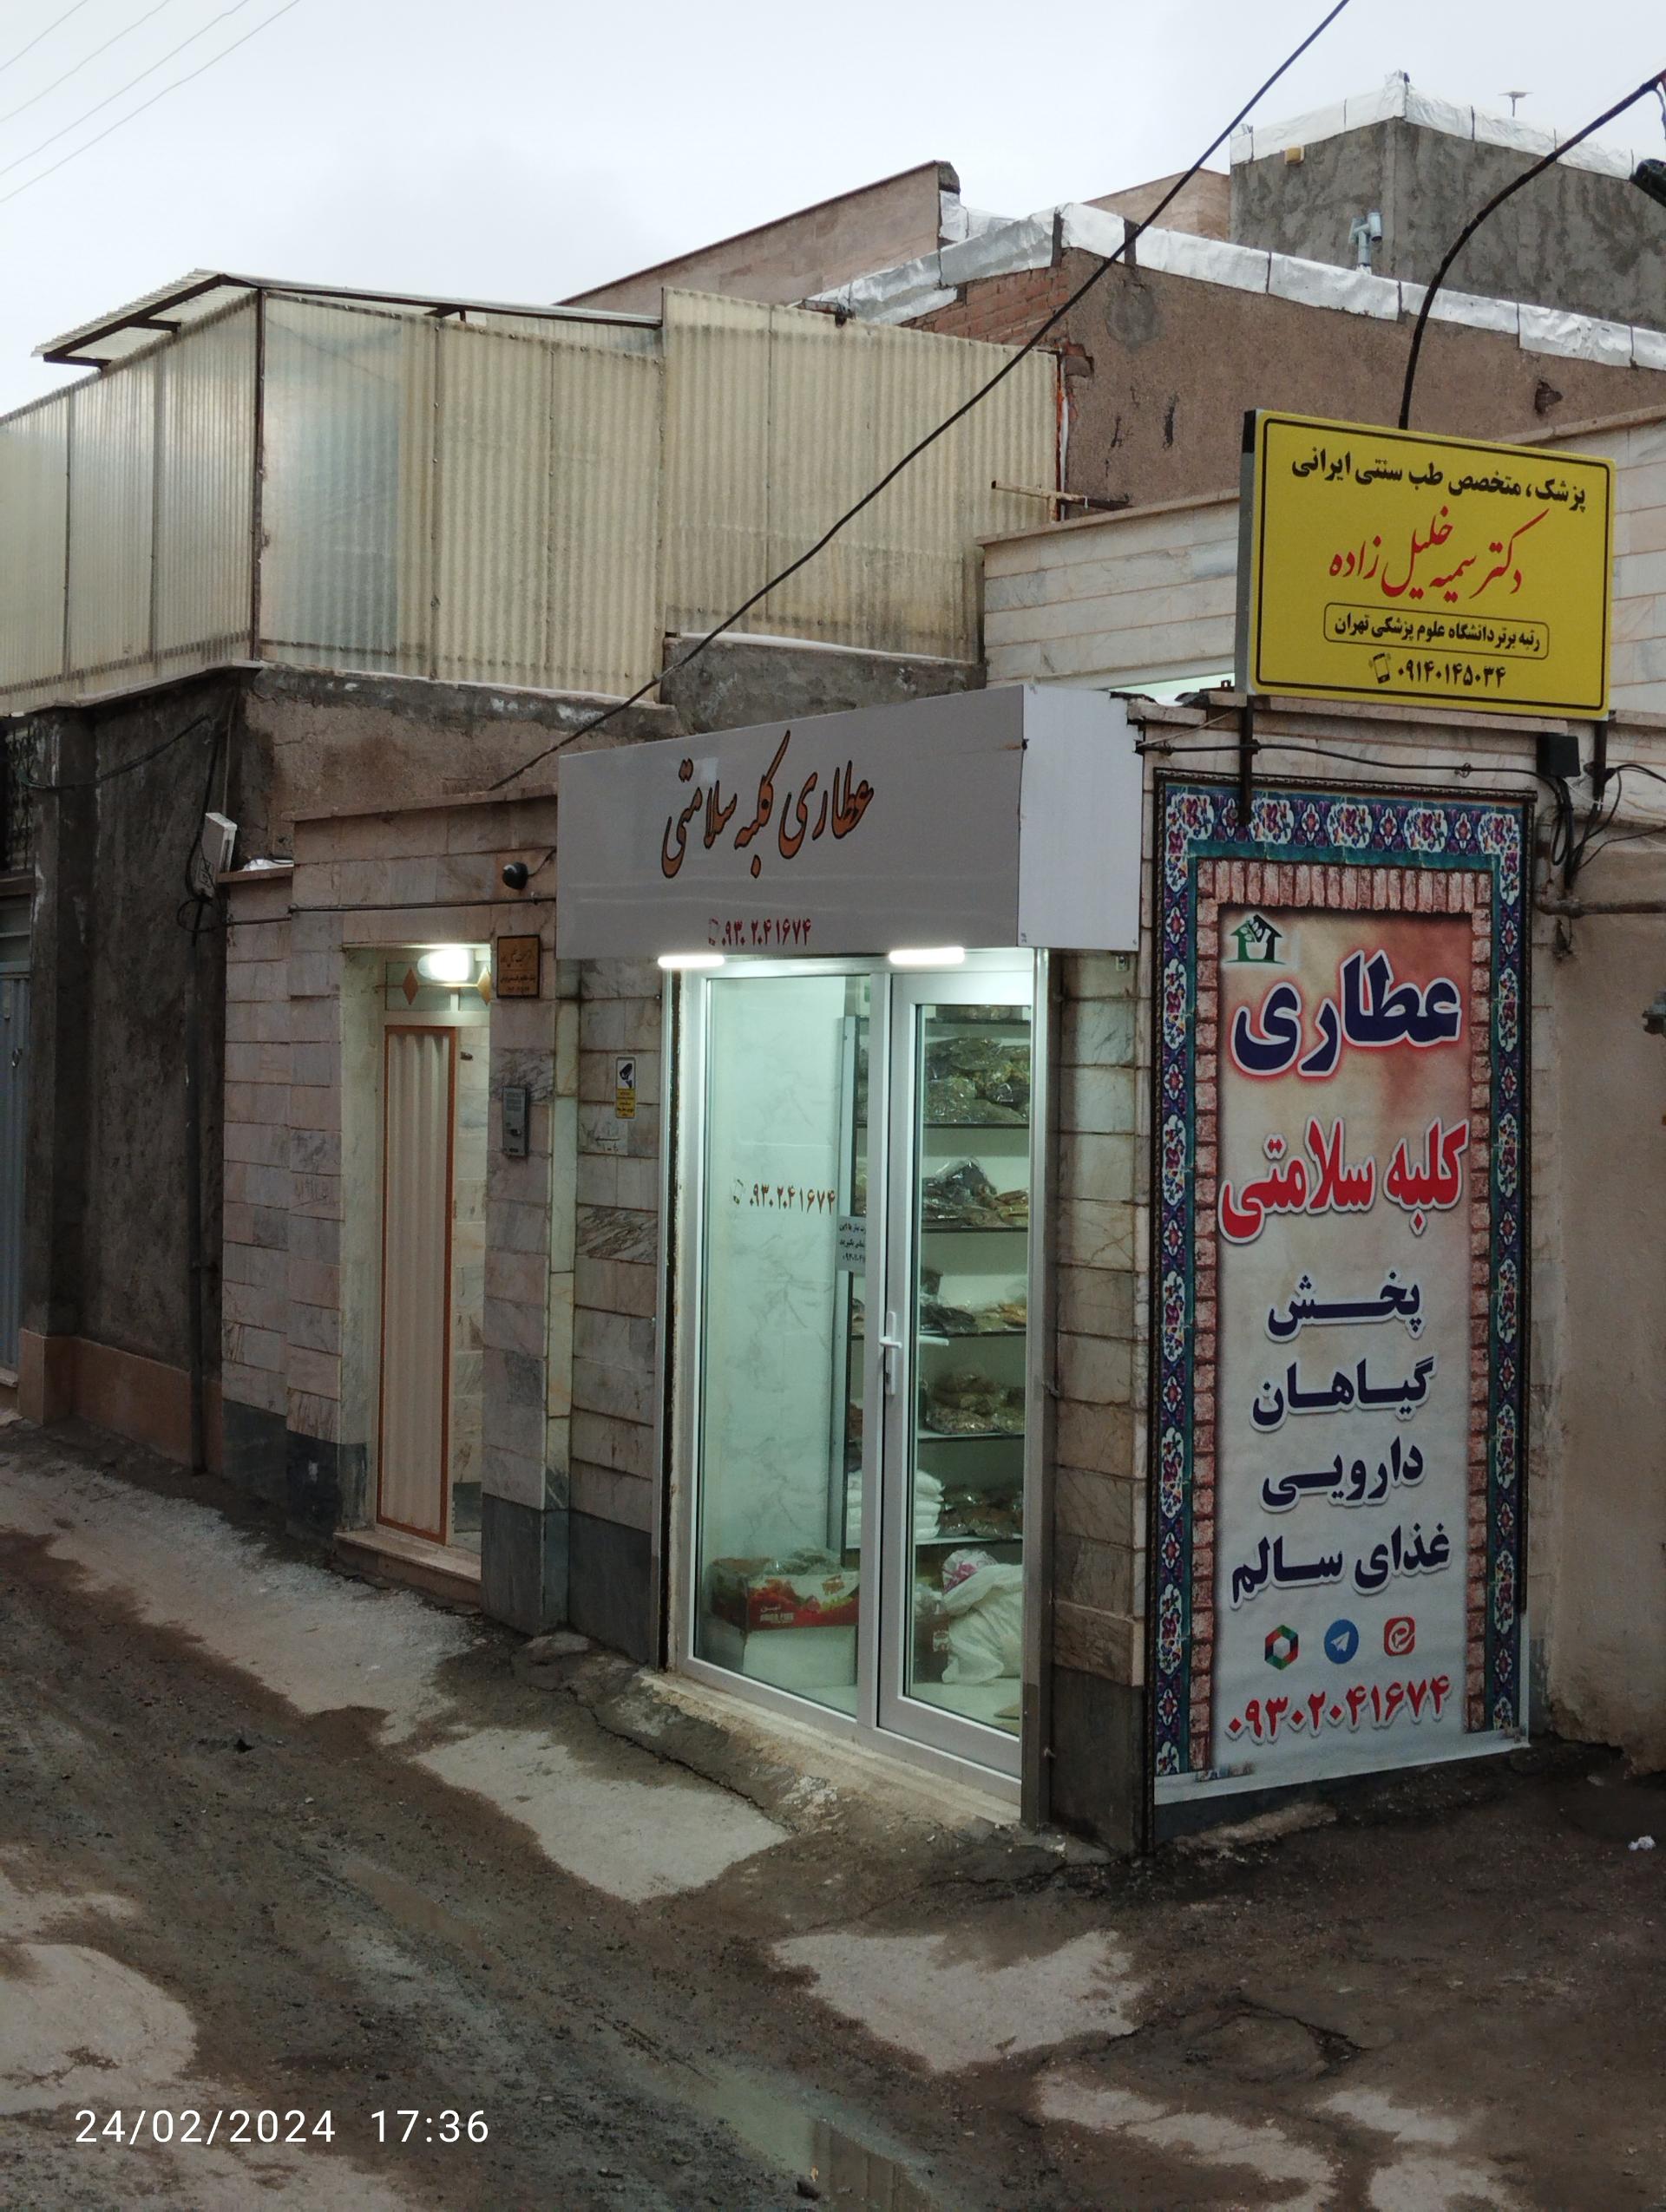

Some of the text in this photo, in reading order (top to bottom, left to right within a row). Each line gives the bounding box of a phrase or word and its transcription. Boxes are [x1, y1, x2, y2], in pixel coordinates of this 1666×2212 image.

[1291, 447, 1351, 481] ایرانی
[1354, 459, 1403, 485] سنتی
[1408, 461, 1444, 490] طب
[1447, 470, 1522, 496] متخصص
[1328, 505, 1550, 603] دکتر سمیه خلیل زاده
[1335, 612, 1540, 651] رتبه برتر دانشگاه علوم پزشکی تهران
[1397, 658, 1506, 688] ۰۹۱۴۰۱۴۵۰۳۴
[661, 730, 875, 879] عطاری کلبه سلامتی
[1233, 951, 1460, 1074] عطاری
[1220, 1117, 1469, 1241] کلبه سلامتی
[1267, 1270, 1421, 1338] پخش
[1251, 1355, 1434, 1427] گیاهان
[1261, 1436, 1425, 1508] دارویی
[1230, 1522, 1452, 1605] غذای سالم
[1226, 1674, 1452, 1738] ۰۹۳۰۲۰۴۱۶۷۴
